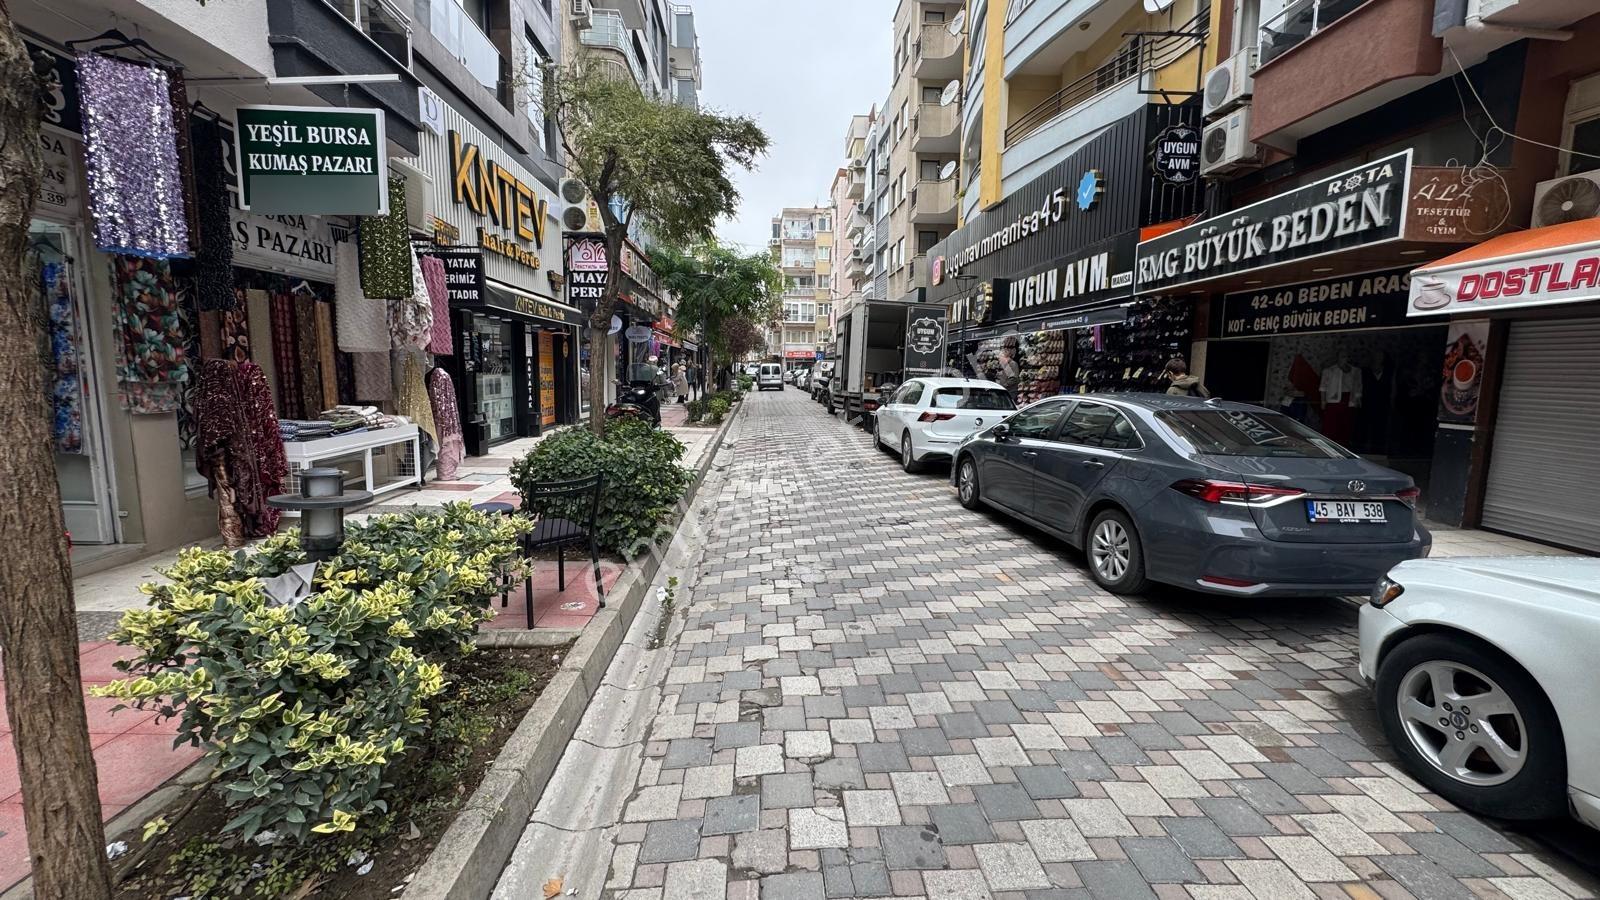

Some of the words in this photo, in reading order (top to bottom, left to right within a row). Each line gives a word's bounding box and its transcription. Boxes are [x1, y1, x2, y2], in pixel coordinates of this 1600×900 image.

[246, 120, 302, 147] YEŞİL
[306, 126, 371, 146] BURSA
[1163, 142, 1197, 154] UYGUN
[248, 153, 308, 176] KUMAŞ
[311, 155, 373, 173] PAZARI
[1168, 158, 1190, 170] AVM
[448, 129, 547, 249] KNTEV
[944, 186, 1067, 278] uygunavmmanisa45
[1137, 248, 1179, 285] RMG
[1182, 215, 1267, 274] BÜYÜK
[1268, 182, 1394, 253] BEDEN
[1438, 217, 1446, 226] &
[255, 225, 333, 265] PAZARI
[446, 258, 477, 269] YATAK
[445, 272, 476, 284] ERİMİZ
[1008, 269, 1058, 311] UYGUN
[1063, 252, 1109, 298] AVM
[1456, 257, 1600, 303] DOSTLA
[447, 289, 479, 300] TTADIR
[1251, 291, 1293, 310] 42-60
[1298, 281, 1353, 304] BEDEN
[1359, 274, 1411, 297] ARAS
[1228, 319, 1245, 333] KOT
[1253, 315, 1280, 333] GENÇ
[1282, 309, 1321, 329] BÜYÜK
[1324, 306, 1367, 325] BEDEN
[1315, 502, 1328, 517] 45
[1336, 503, 1355, 517] BAV
[1363, 503, 1383, 518] 538
